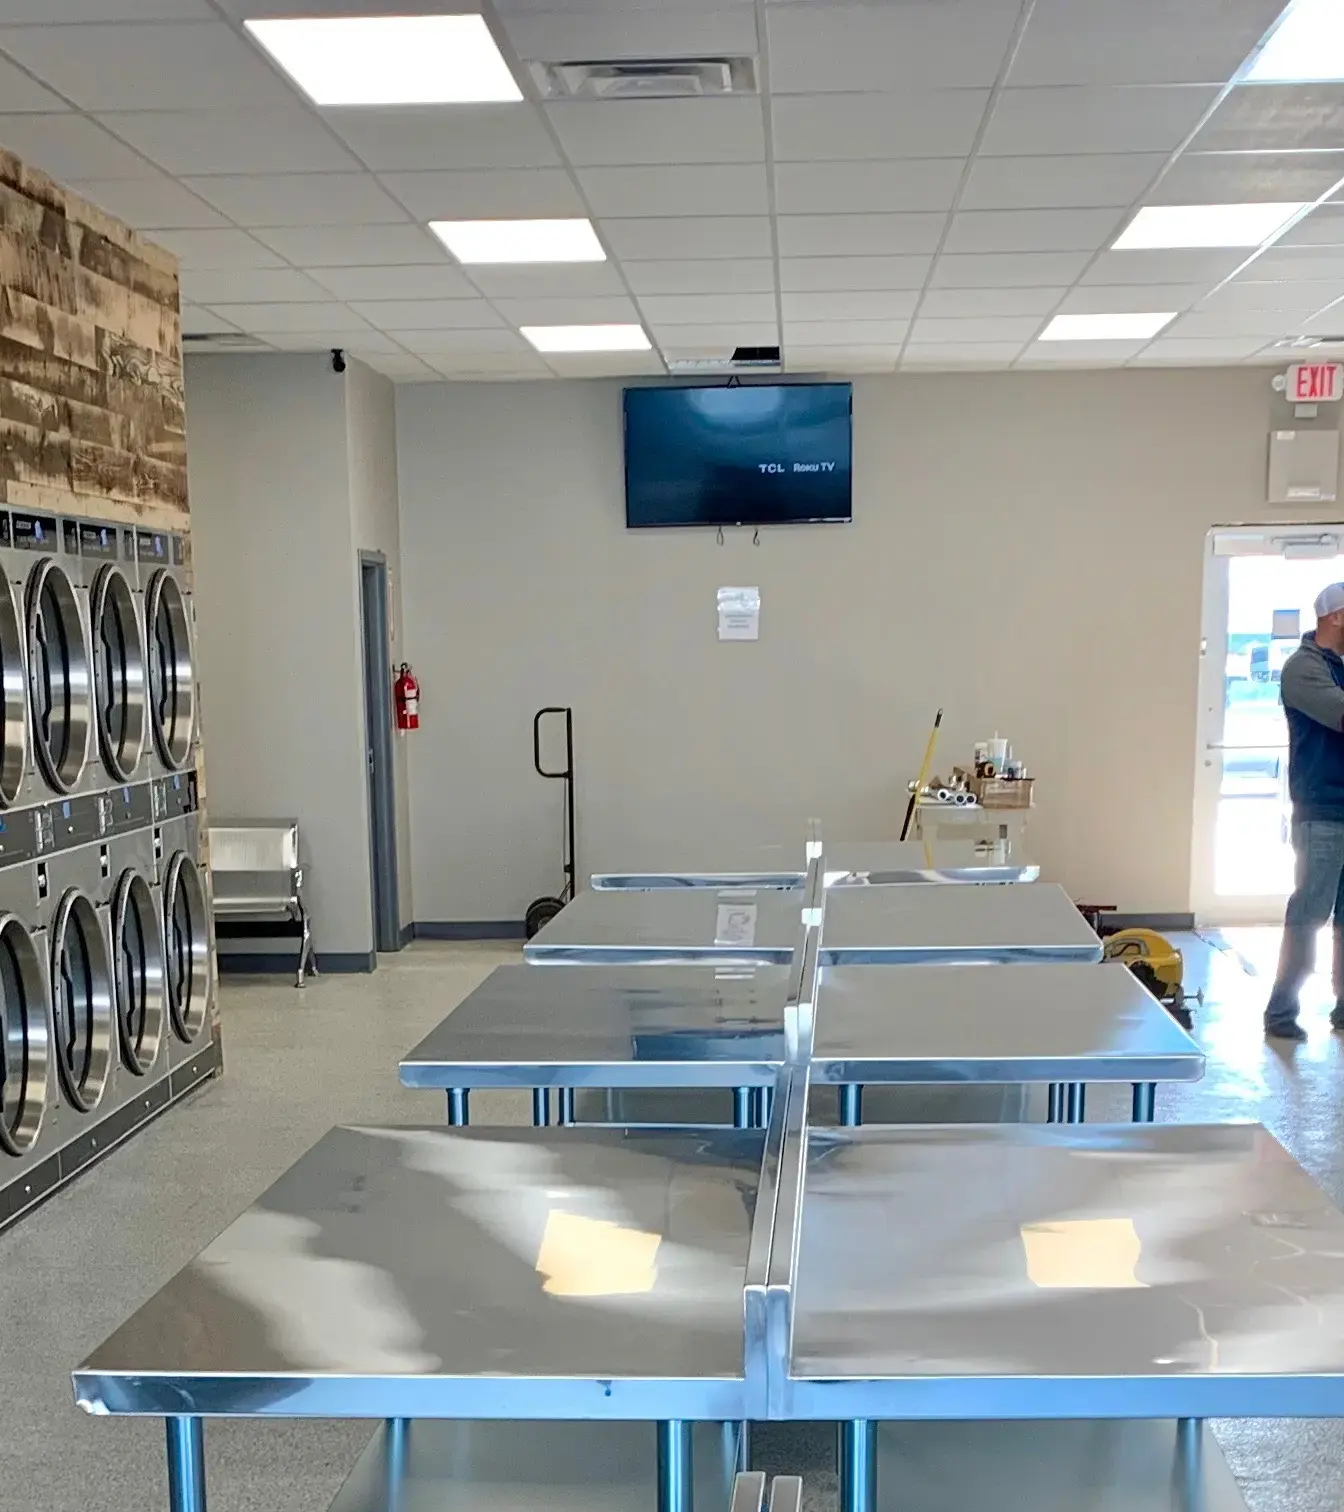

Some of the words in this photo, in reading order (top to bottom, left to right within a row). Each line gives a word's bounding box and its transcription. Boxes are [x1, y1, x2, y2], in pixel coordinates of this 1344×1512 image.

[1297, 366, 1337, 398] EXIT
[758, 463, 785, 473] TCL
[820, 461, 835, 471] TV
